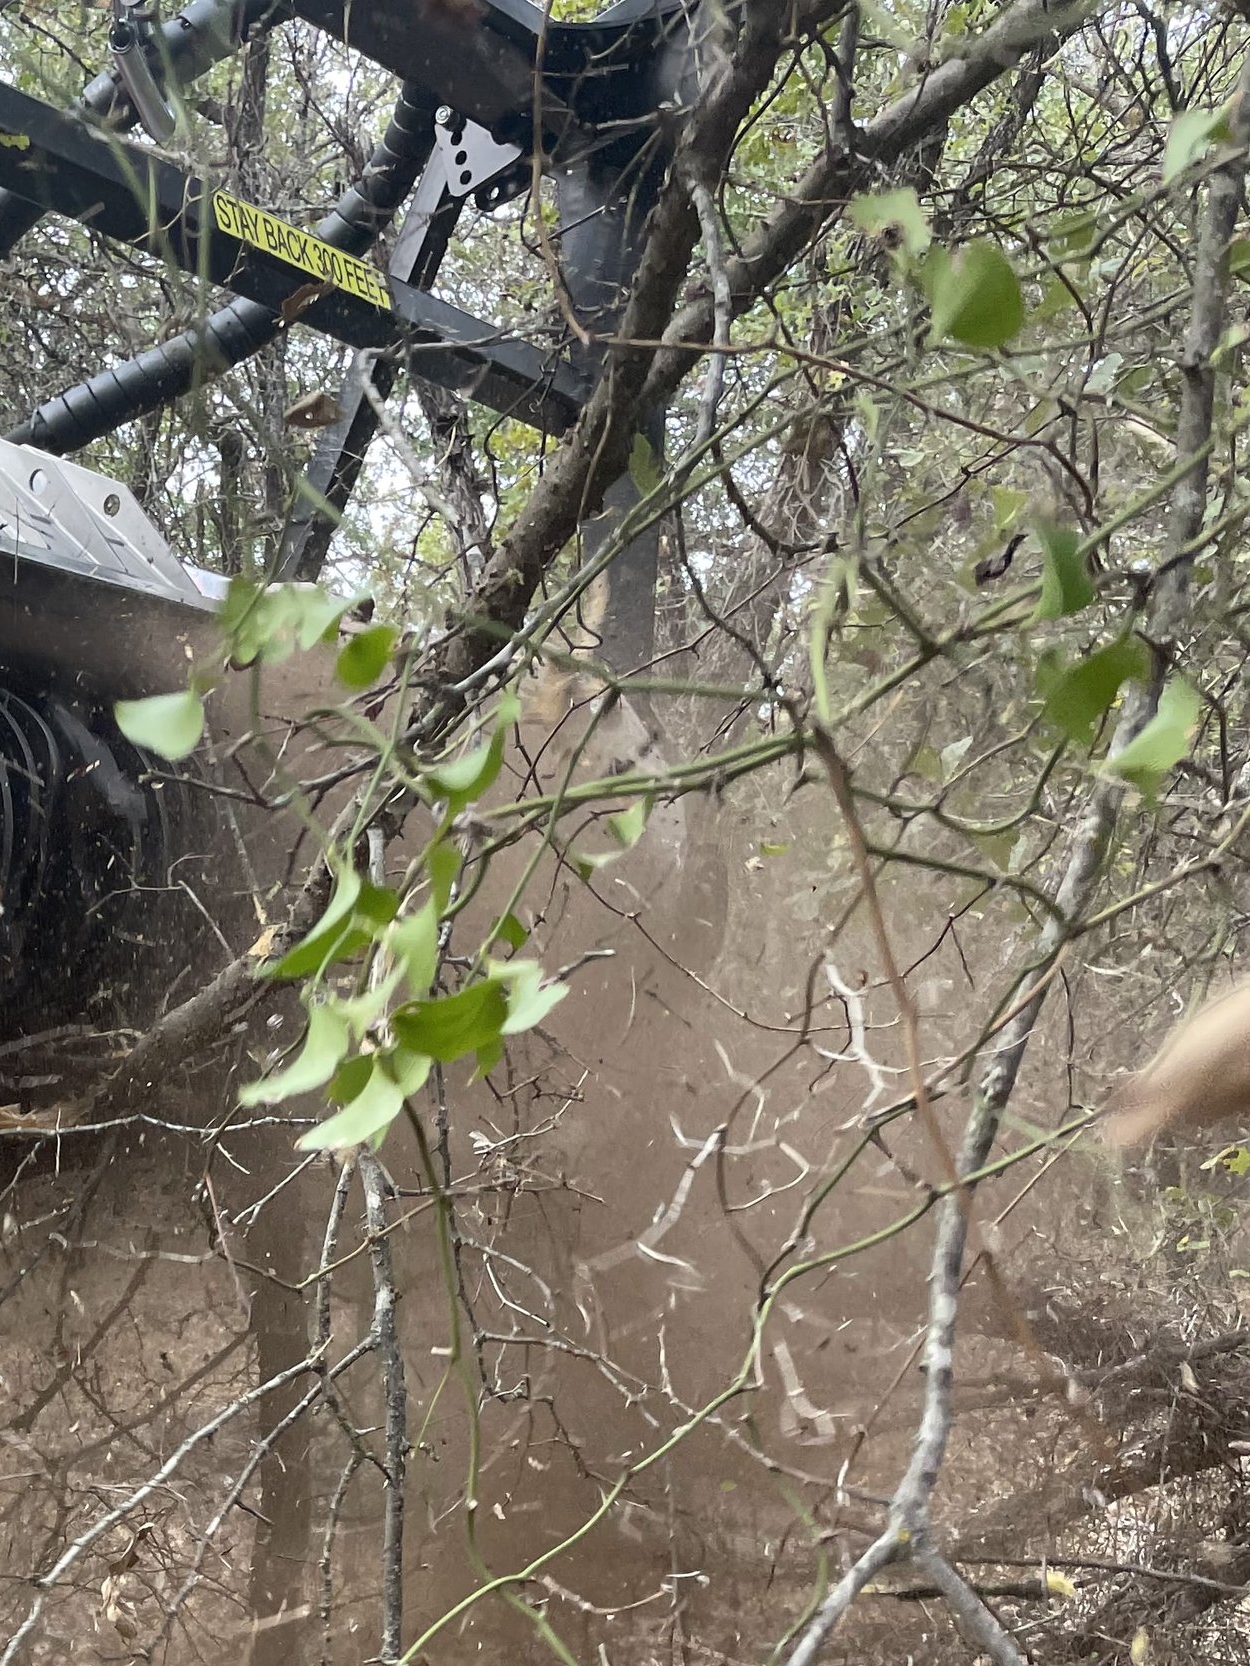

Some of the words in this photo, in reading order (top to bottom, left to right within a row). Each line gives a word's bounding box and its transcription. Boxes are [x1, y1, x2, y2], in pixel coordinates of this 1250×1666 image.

[217, 194, 260, 243] STAY
[263, 217, 314, 270] BACK
[313, 244, 343, 284] 300
